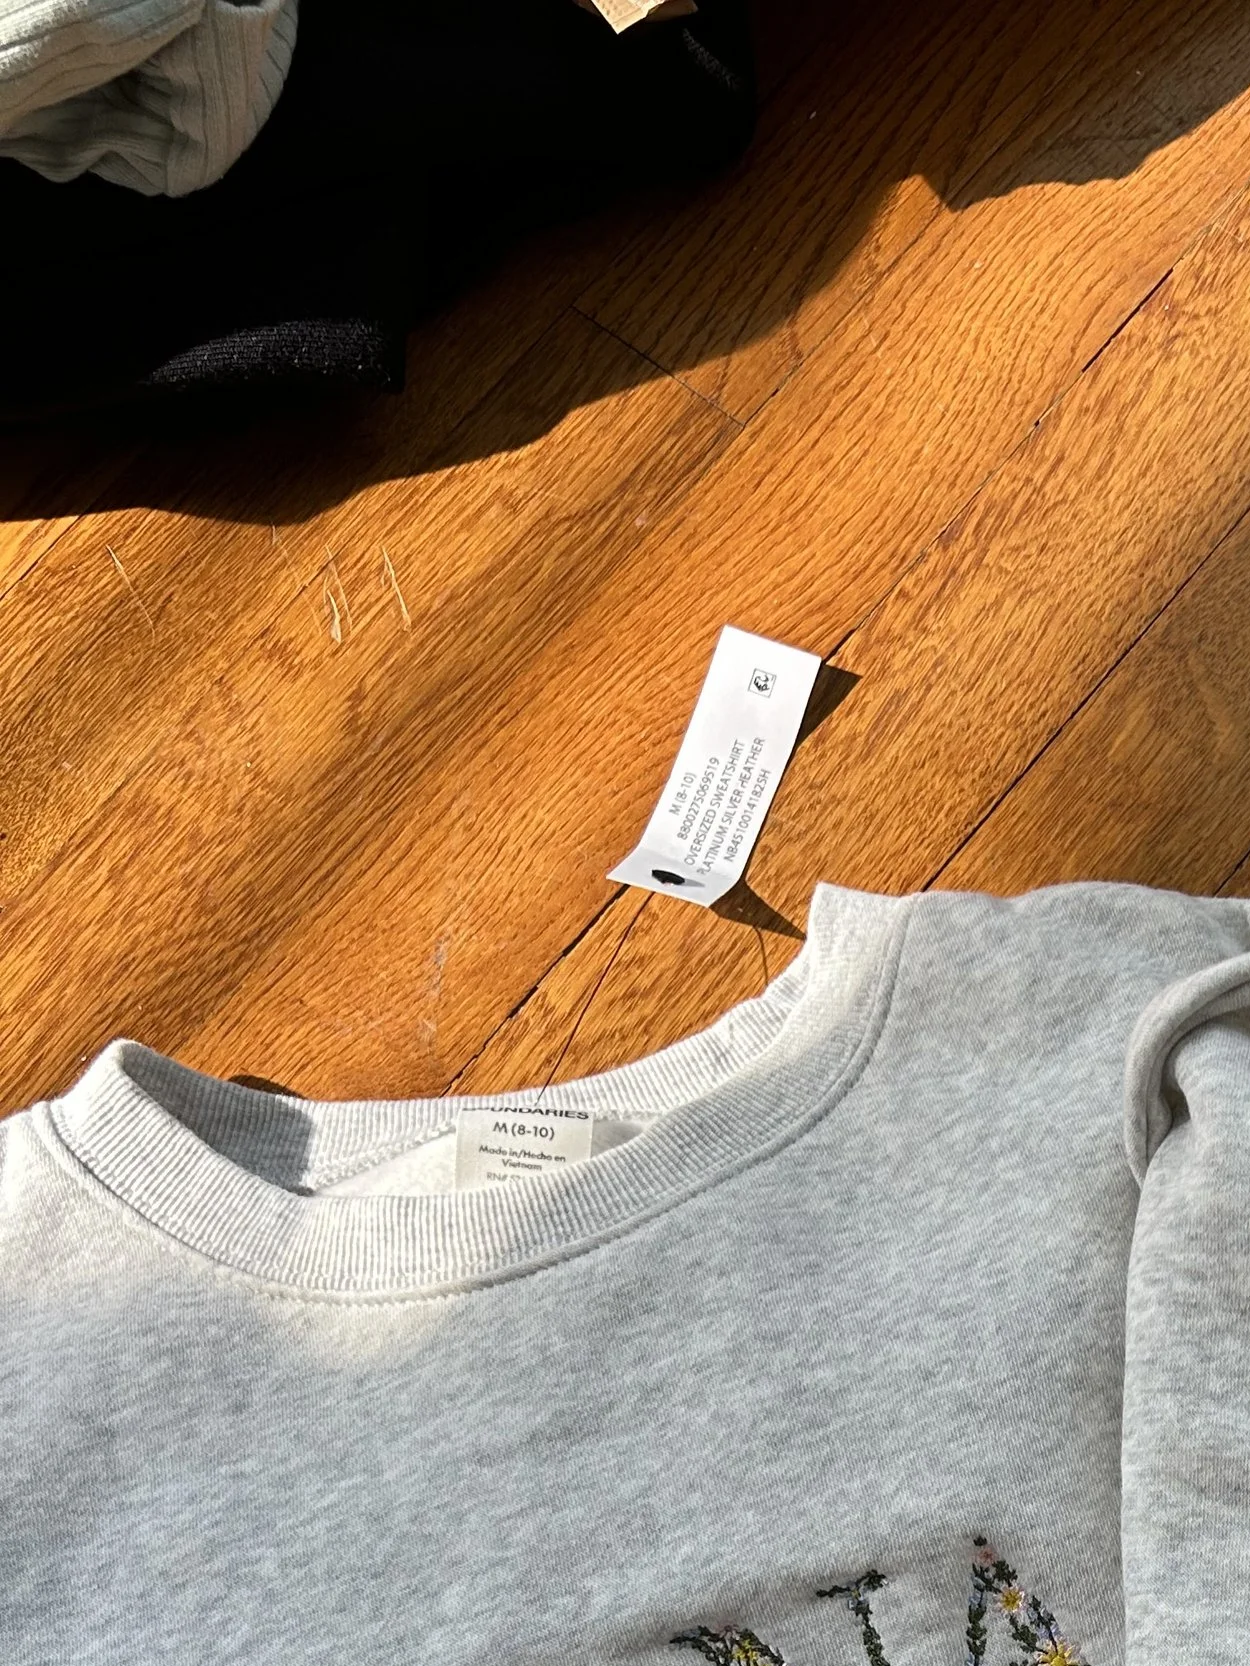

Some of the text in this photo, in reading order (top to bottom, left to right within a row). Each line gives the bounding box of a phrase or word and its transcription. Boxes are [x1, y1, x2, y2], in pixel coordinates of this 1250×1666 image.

[669, 772, 697, 815] M (8-10)
[677, 757, 720, 840] 8800275069519
[684, 739, 745, 866] OVERSIZED SWEATSHIRT
[696, 737, 766, 875] PLATINUM SILVER HEATHER
[462, 1107, 589, 1120] UNDARIES
[493, 1121, 555, 1141] M (8-10)
[479, 1144, 508, 1156] Made
[554, 1155, 566, 1163] en
[501, 1158, 542, 1171] Vietnam
